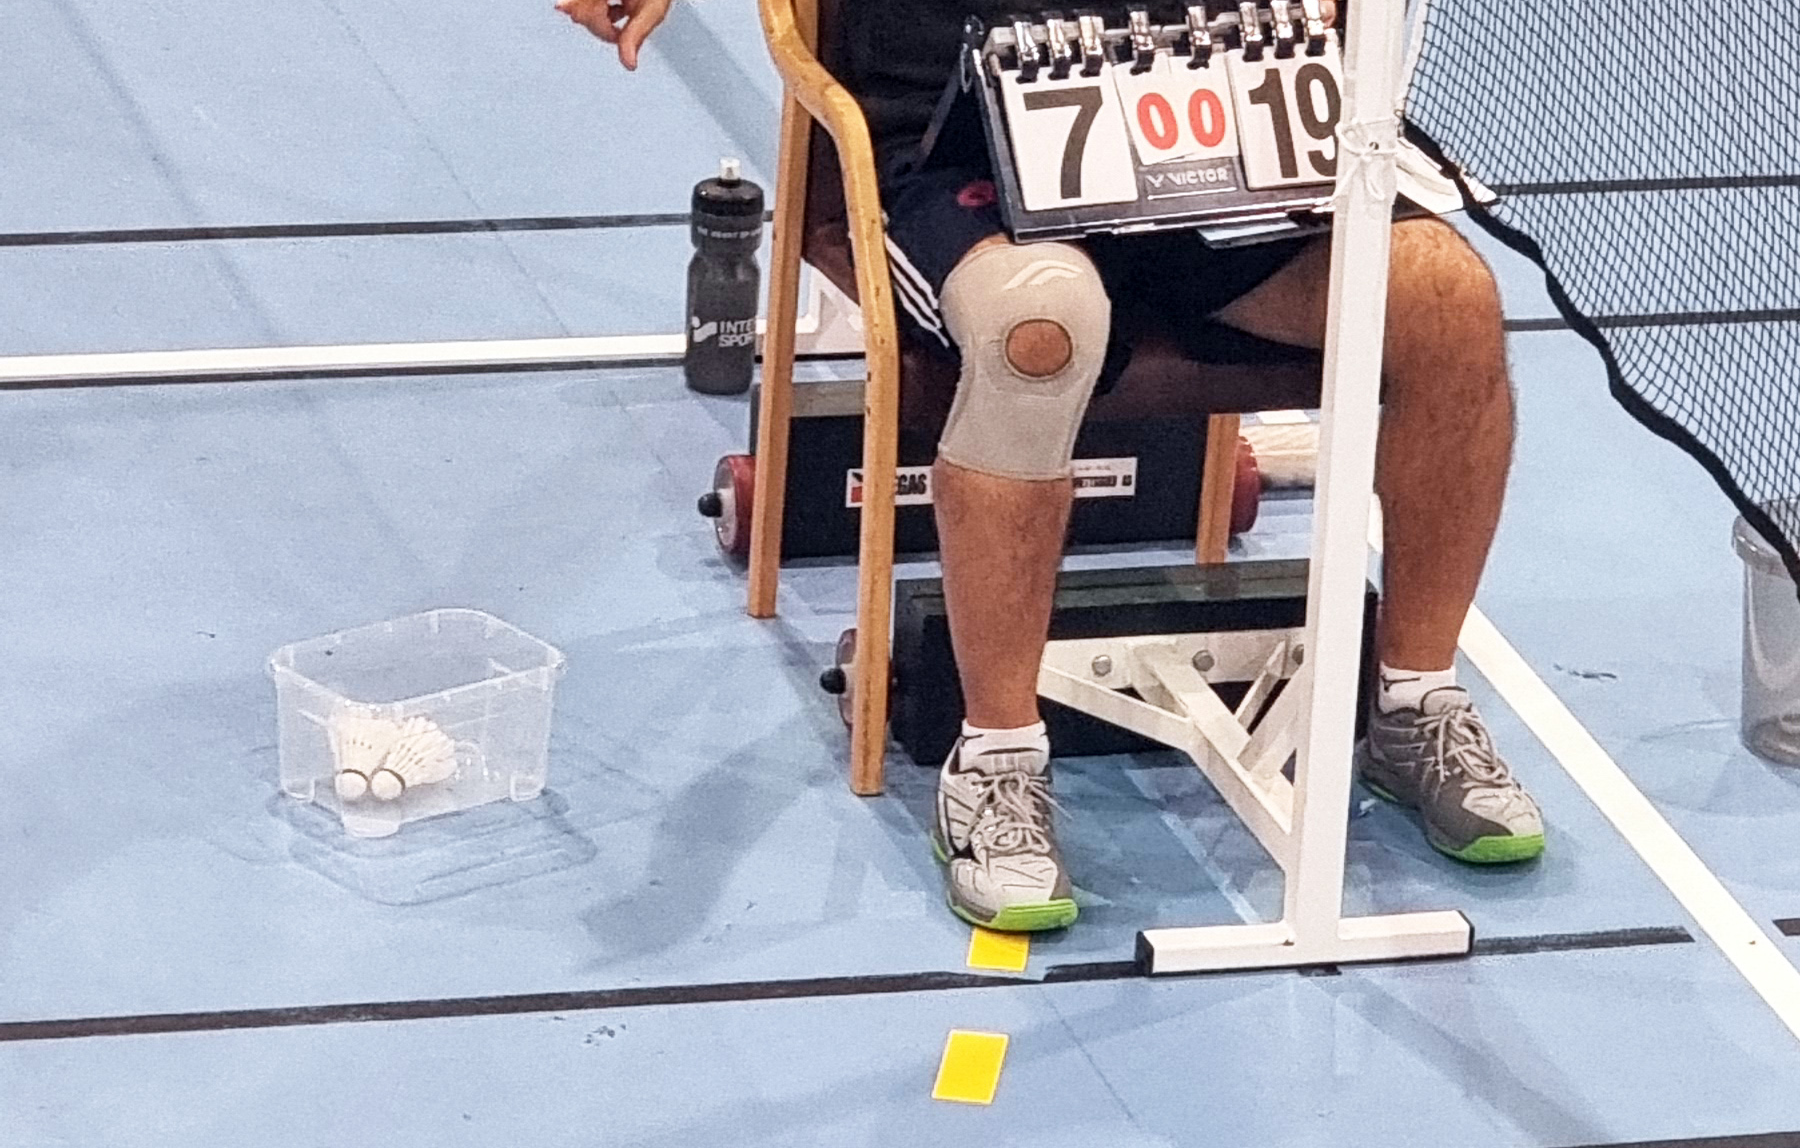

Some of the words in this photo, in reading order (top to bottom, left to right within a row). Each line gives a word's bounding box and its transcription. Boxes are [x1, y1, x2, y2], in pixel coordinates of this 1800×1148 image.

[1023, 85, 1104, 200] 7
[1166, 167, 1229, 186] VICTOR
[1248, 62, 1342, 178] 19
